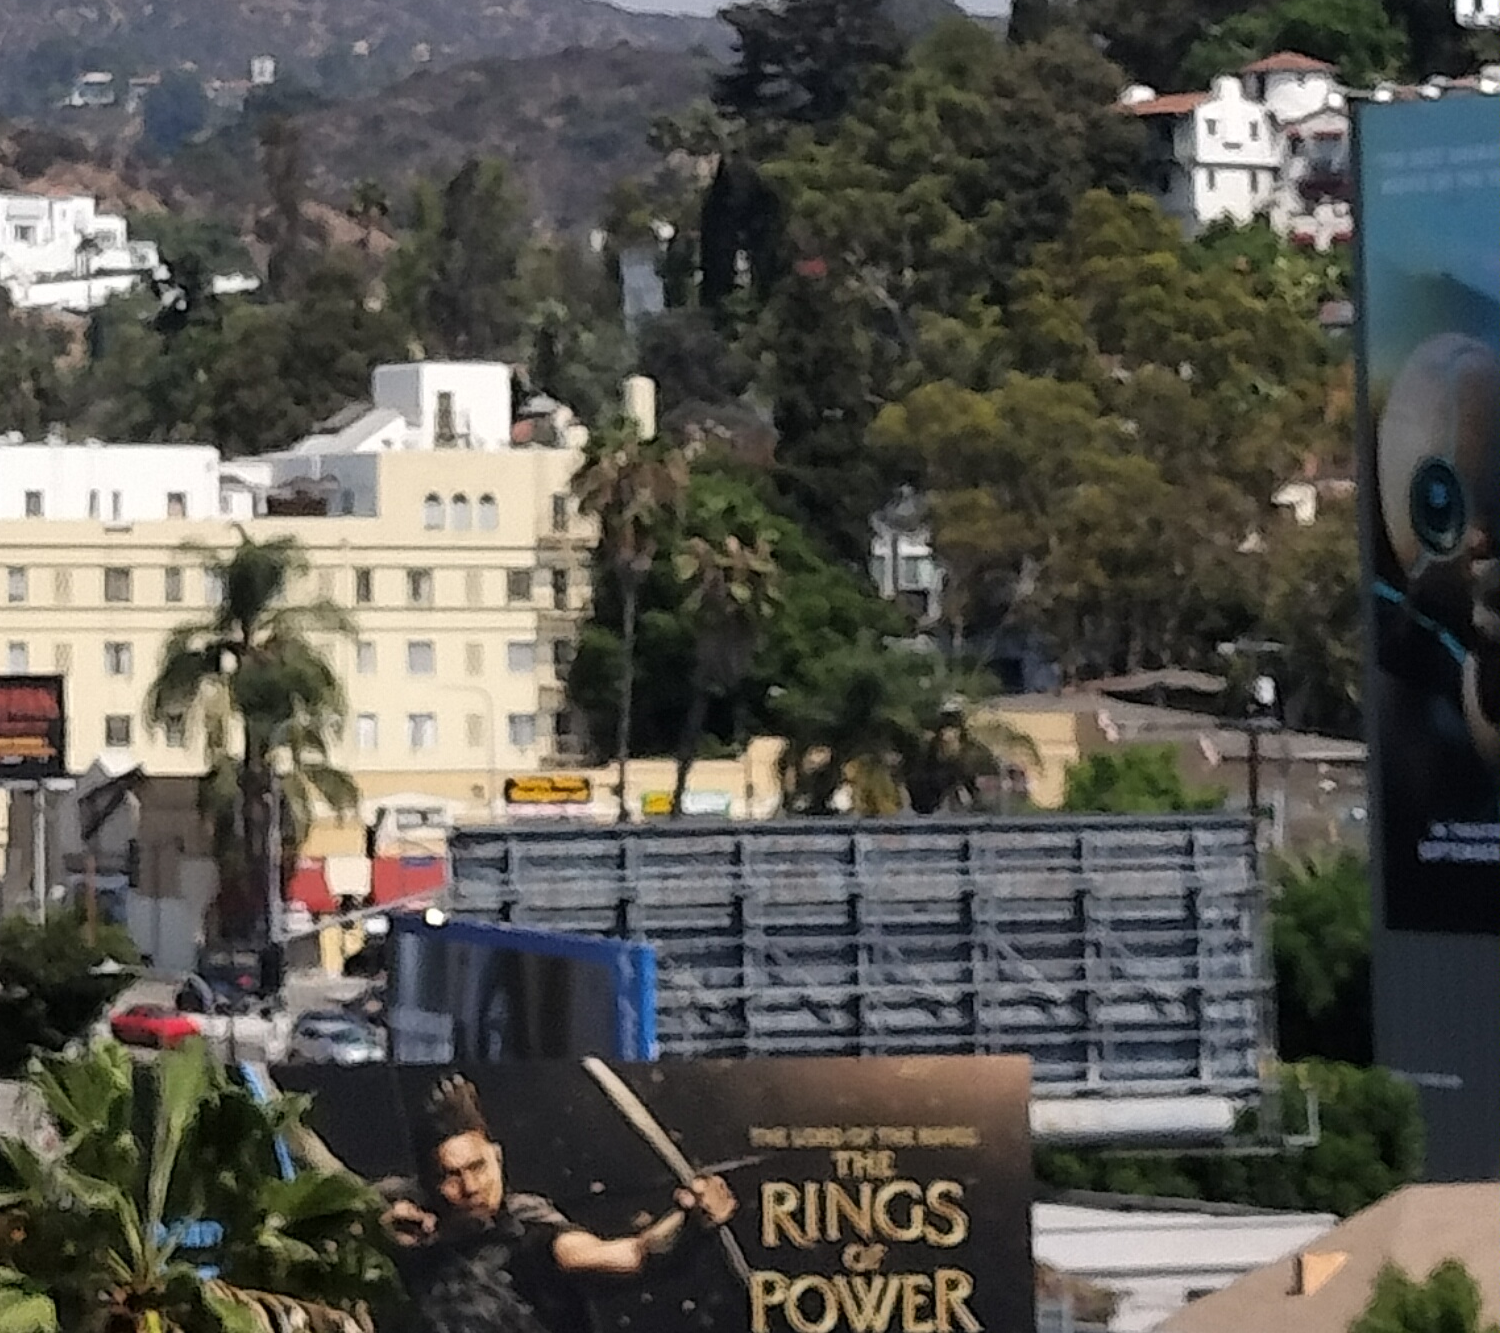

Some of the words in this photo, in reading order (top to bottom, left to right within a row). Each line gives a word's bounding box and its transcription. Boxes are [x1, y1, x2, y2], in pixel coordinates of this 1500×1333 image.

[831, 1150, 897, 1179] THE
[761, 1180, 970, 1248] RINGS
[750, 1267, 985, 1333] POWER
